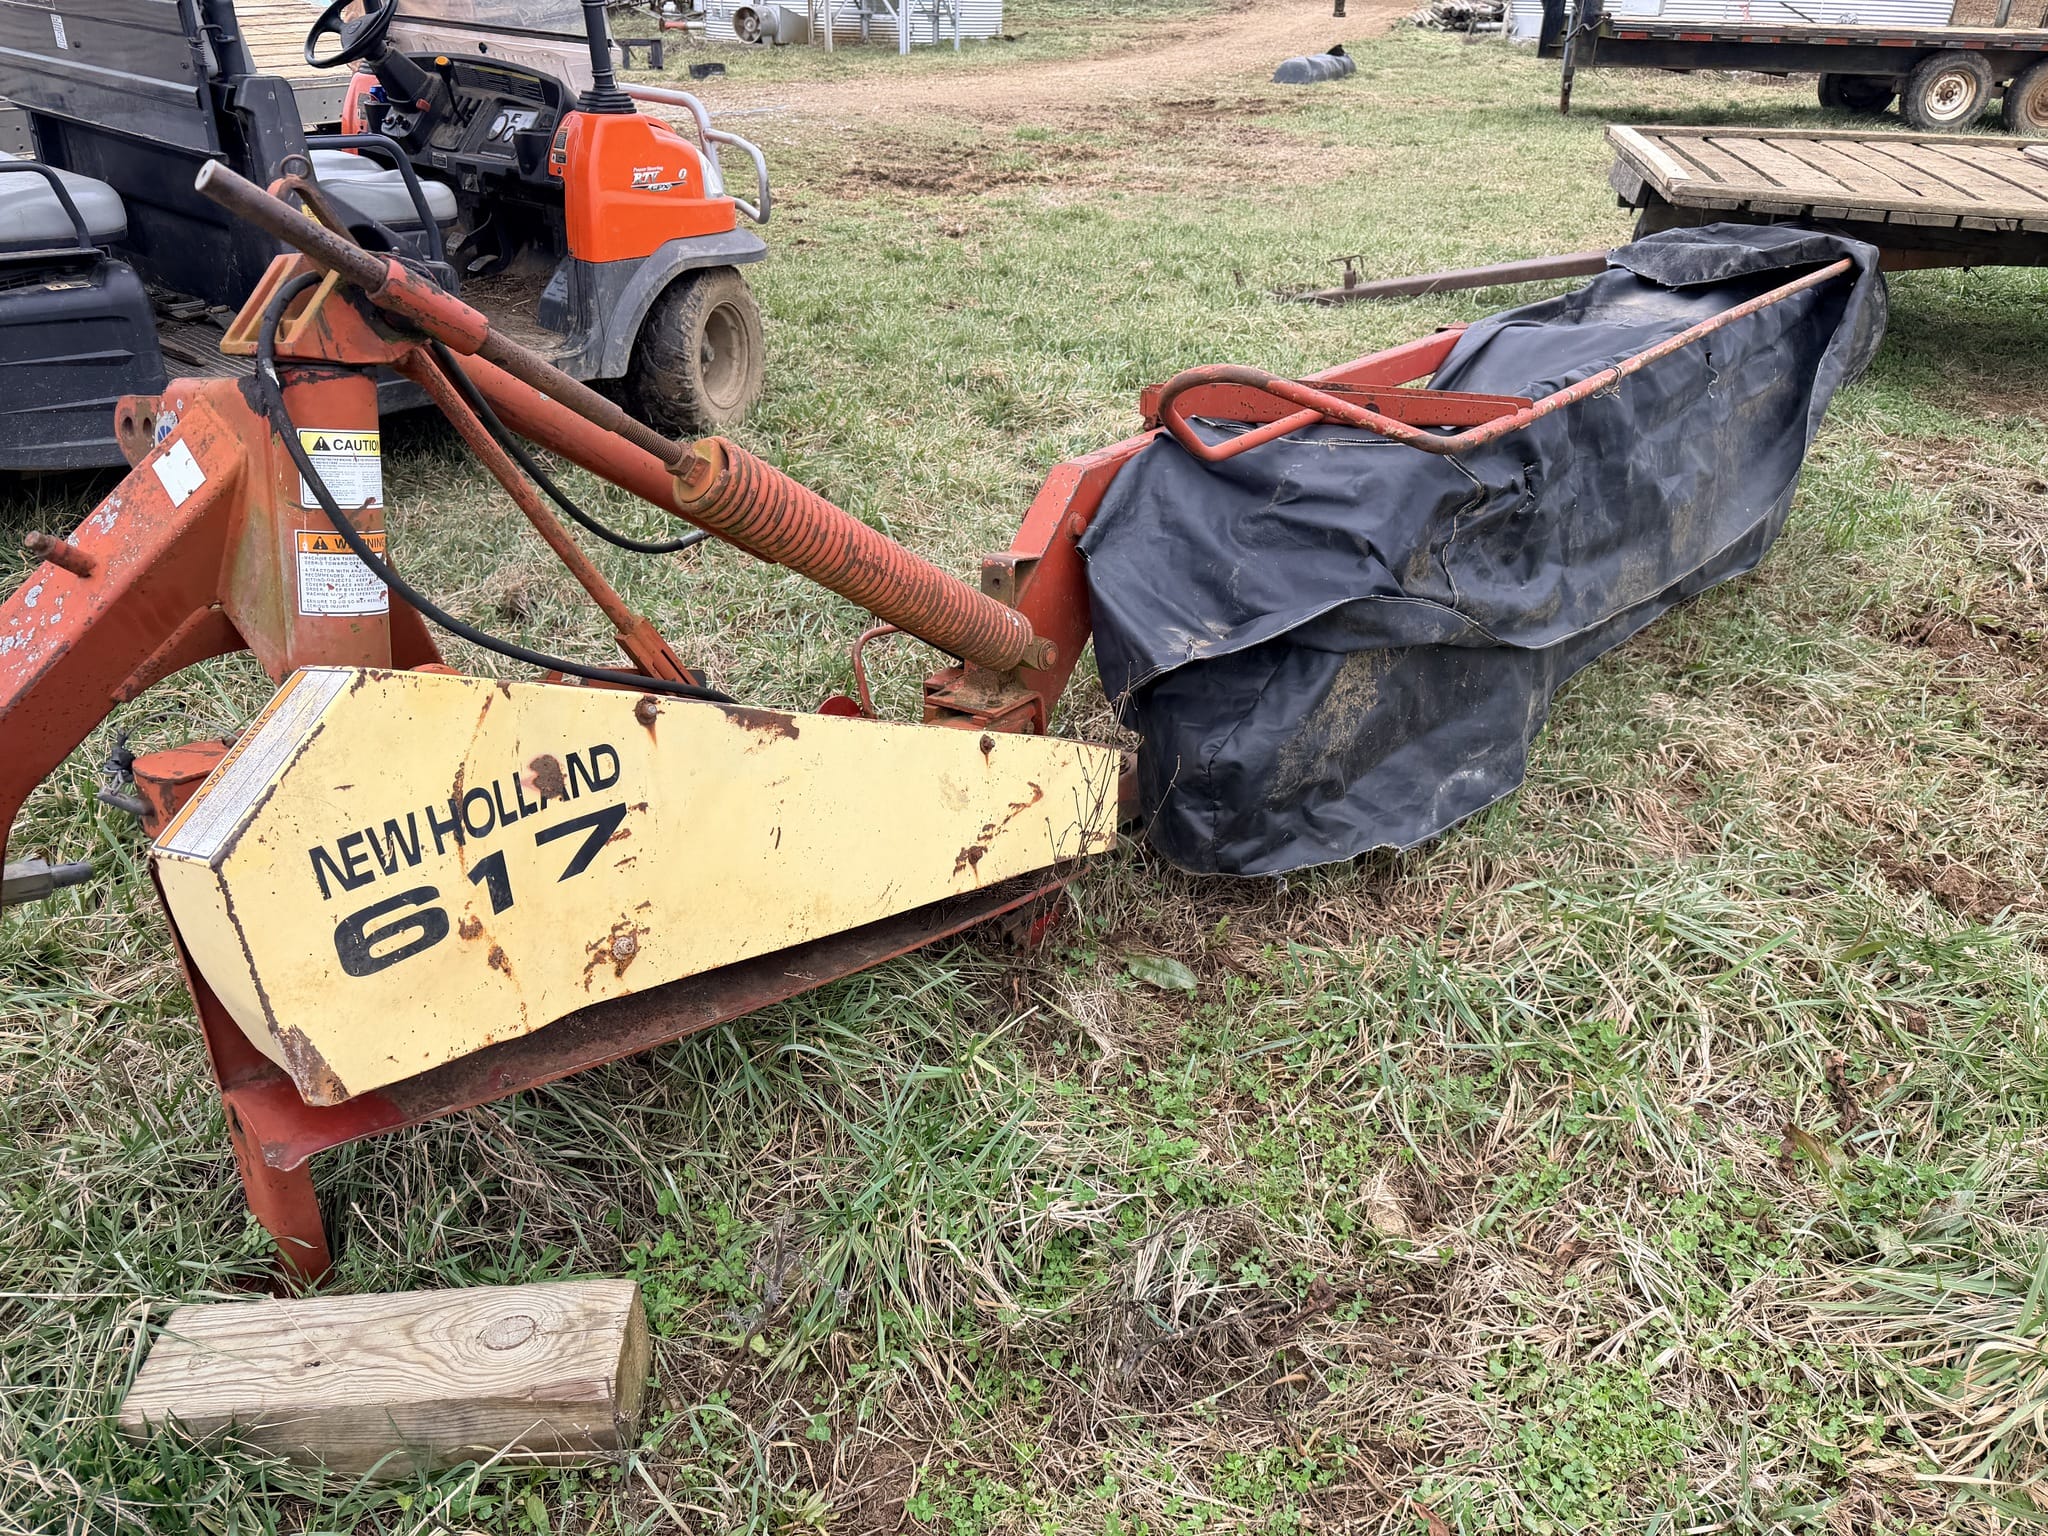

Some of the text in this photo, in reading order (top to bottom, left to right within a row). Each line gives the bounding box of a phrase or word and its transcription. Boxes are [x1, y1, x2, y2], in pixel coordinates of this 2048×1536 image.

[632, 171, 660, 184] RTV
[206, 708, 275, 788] WARNING
[308, 812, 422, 901] NEW
[333, 802, 628, 978] 617
